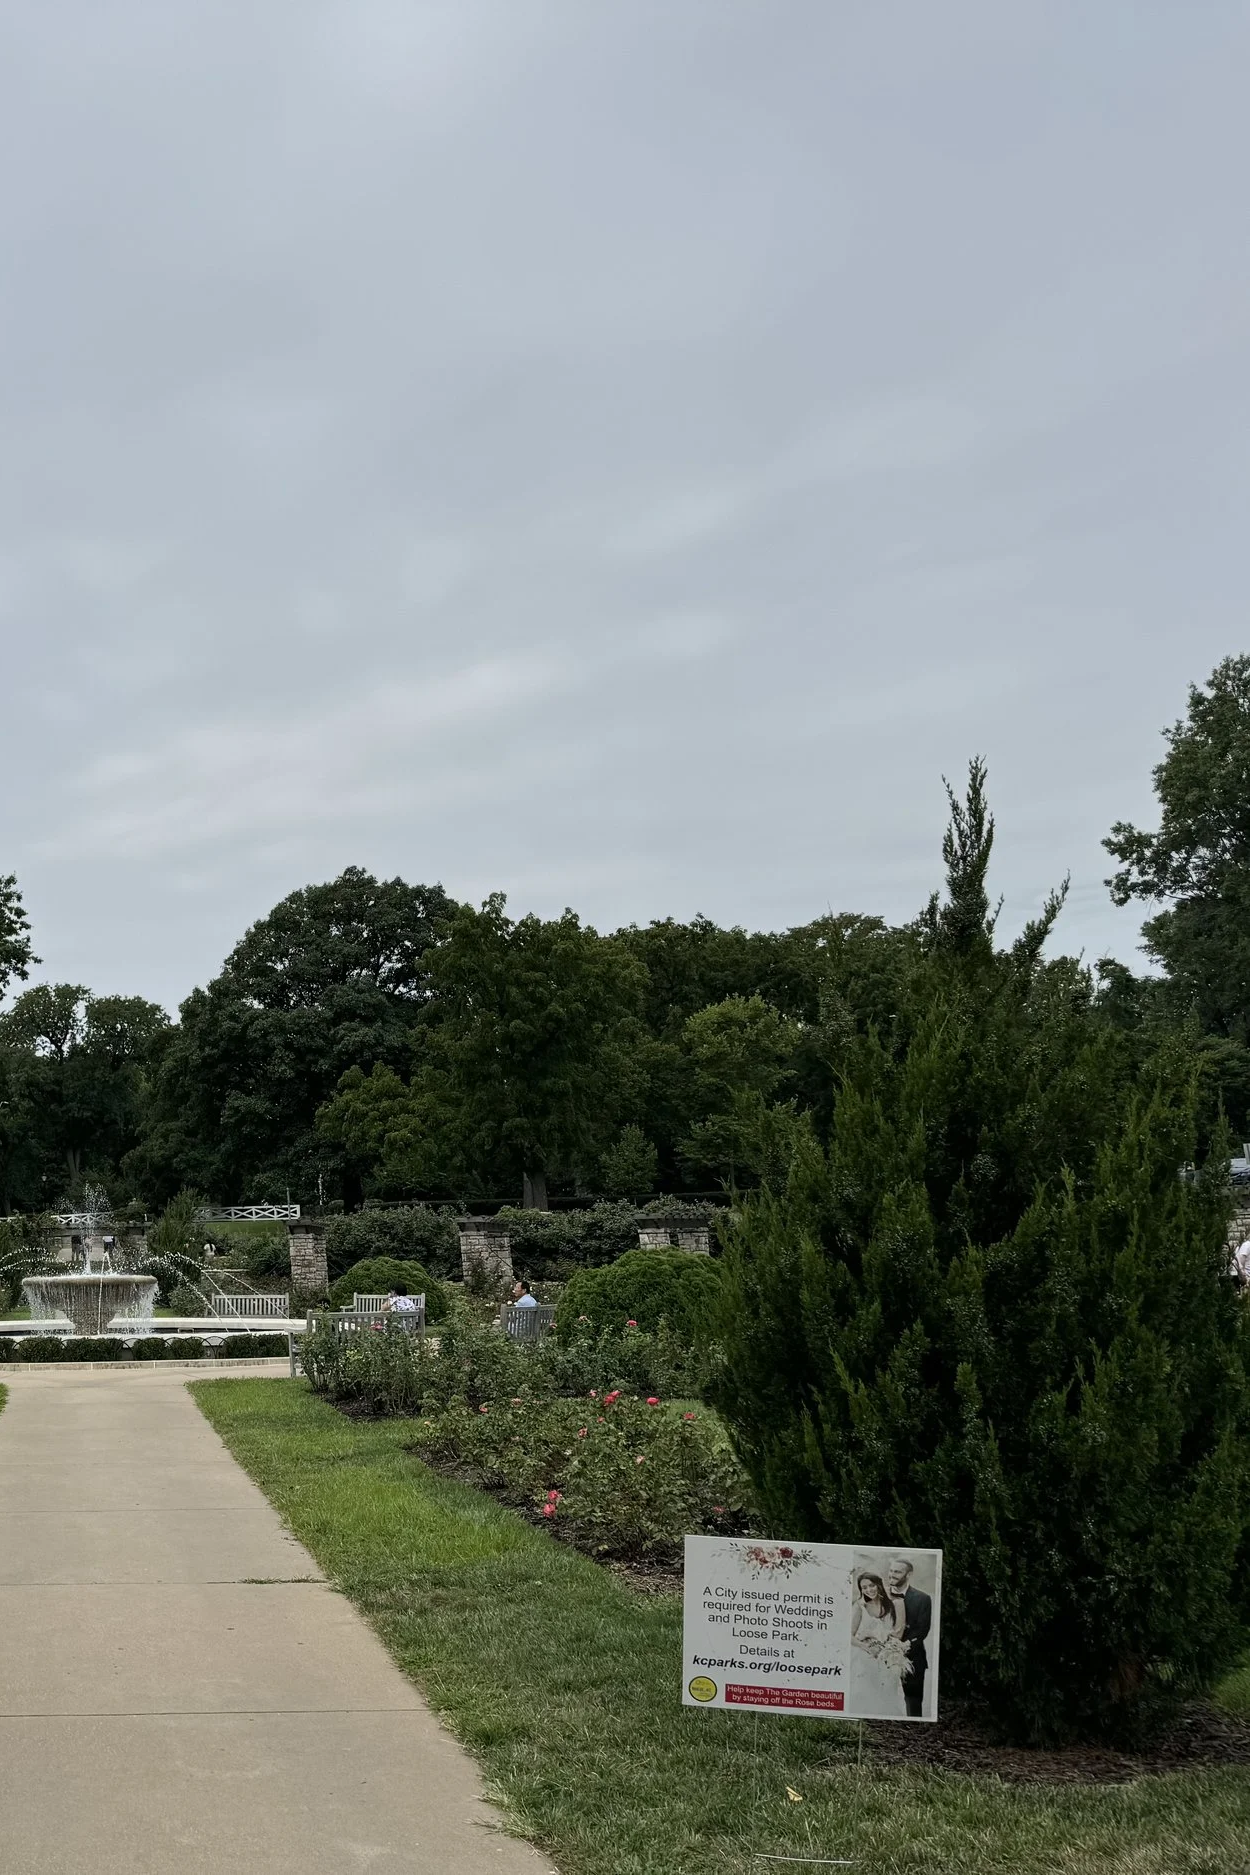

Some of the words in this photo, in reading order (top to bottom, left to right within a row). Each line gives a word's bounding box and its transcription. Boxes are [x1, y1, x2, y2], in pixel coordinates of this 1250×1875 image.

[703, 1586, 712, 1596] A
[715, 1587, 738, 1599] City
[742, 1589, 779, 1601] issued
[784, 1594, 820, 1604] permit
[824, 1595, 834, 1604] is
[703, 1601, 751, 1612] required
[756, 1603, 770, 1613] for
[774, 1604, 834, 1619] Weddings
[708, 1614, 730, 1623] and
[734, 1614, 768, 1626] Photo
[772, 1618, 813, 1629] Shoots
[817, 1620, 827, 1630] in
[732, 1628, 768, 1639] Loose
[740, 1645, 780, 1658] Details
[783, 1648, 794, 1658] at
[693, 1656, 842, 1676] kcparks.org/loosepark
